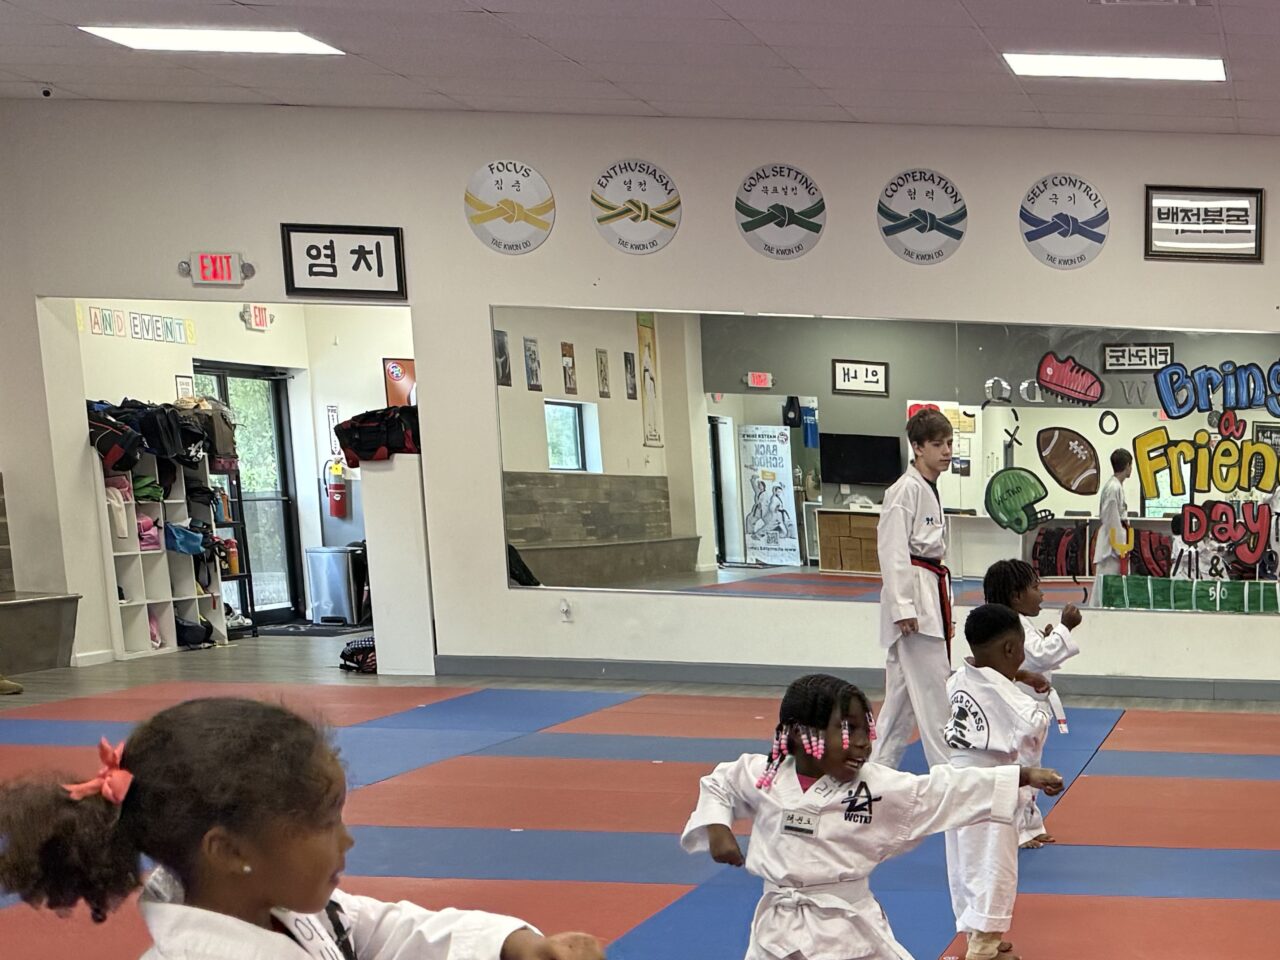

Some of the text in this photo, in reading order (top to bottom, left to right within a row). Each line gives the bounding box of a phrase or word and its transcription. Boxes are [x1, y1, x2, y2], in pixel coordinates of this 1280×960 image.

[488, 161, 531, 178] FOCUS
[597, 161, 675, 195] ENTHUSIASM
[743, 165, 818, 196] GOAL SETTING
[884, 170, 962, 204] COOPERATION
[1027, 175, 1102, 208] SELF CONTROL
[491, 238, 531, 251] TAE KWON DO
[617, 237, 658, 250] TAE KWON DO
[763, 243, 804, 255] TAE KWON DO
[903, 248, 944, 261] TAE KWON DO
[200, 254, 232, 281] EXIT
[1045, 253, 1086, 266] TAE KWON DO
[91, 308, 195, 342] AND EVENTS
[253, 305, 268, 327] EXIT
[1218, 409, 1246, 439] a
[1181, 500, 1271, 565] Day
[965, 699, 985, 731] CLASS
